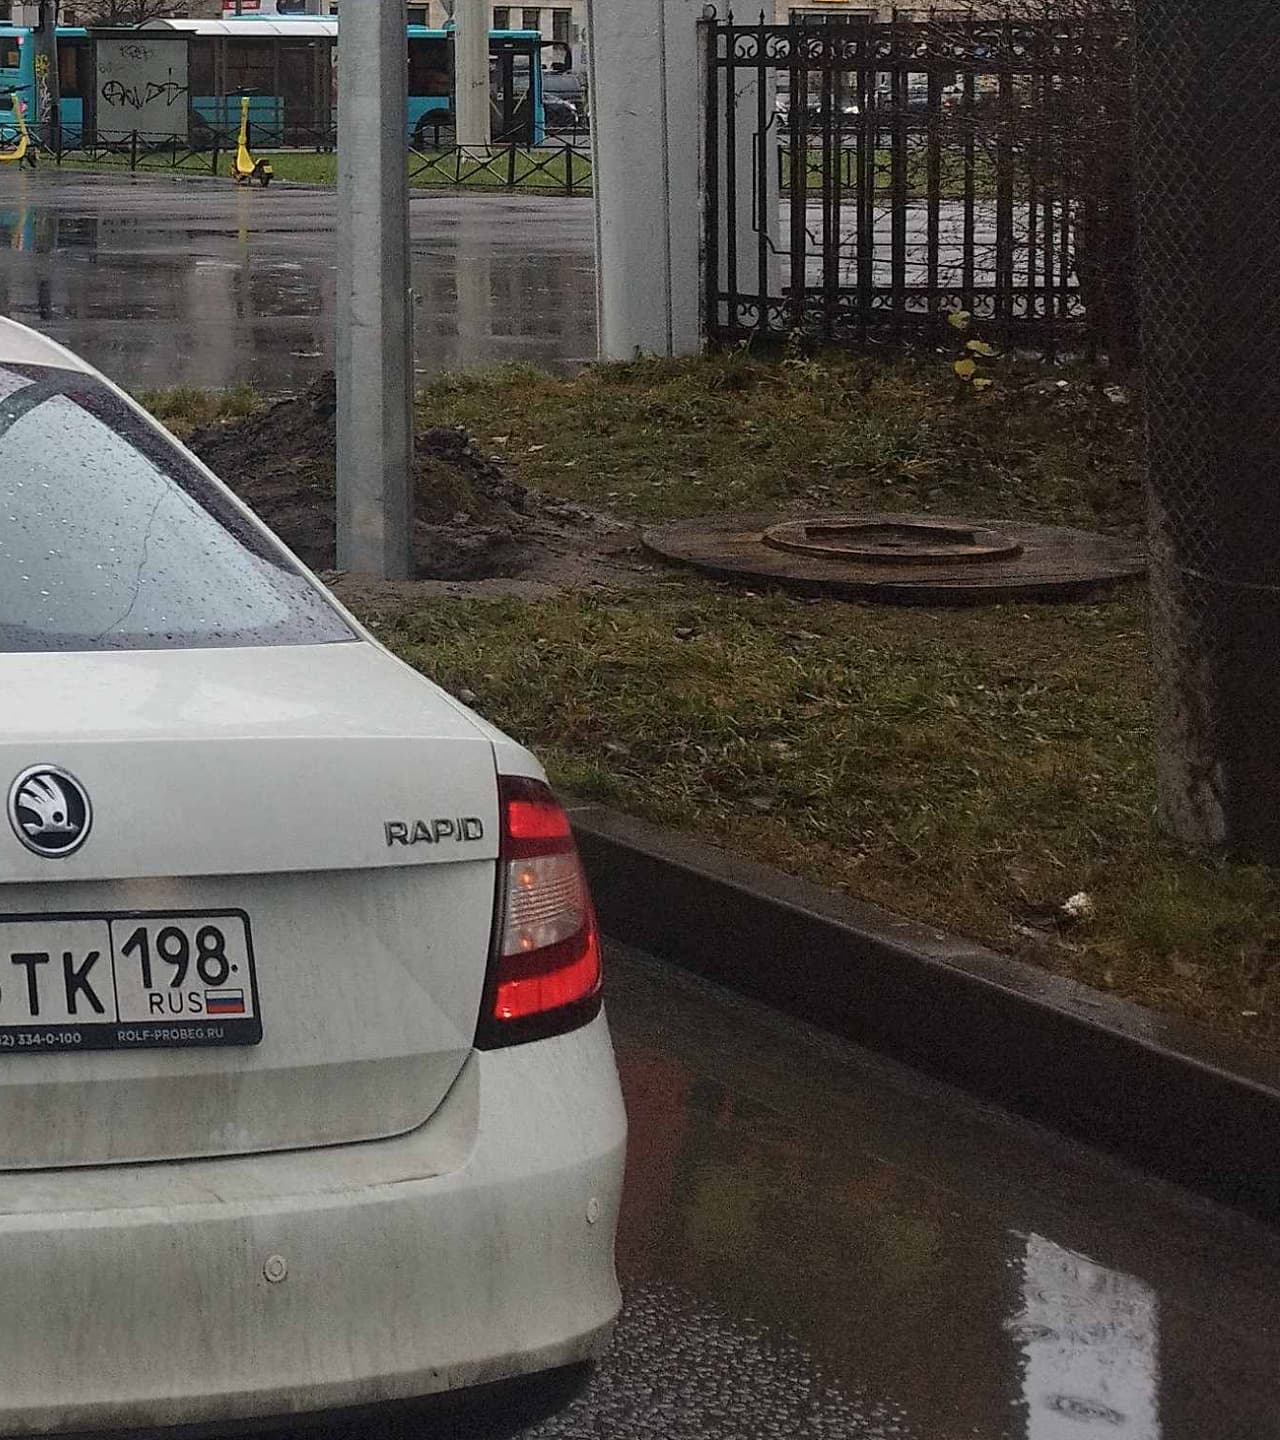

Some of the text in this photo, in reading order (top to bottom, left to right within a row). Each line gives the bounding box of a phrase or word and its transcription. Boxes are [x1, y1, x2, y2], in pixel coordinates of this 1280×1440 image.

[384, 817, 484, 847] RAPID
[120, 925, 227, 990] 198
[148, 991, 203, 1016] RUS
[17, 1032, 82, 1046] 334-0-100
[117, 1027, 225, 1042] ROLF-PROBEG.RU
